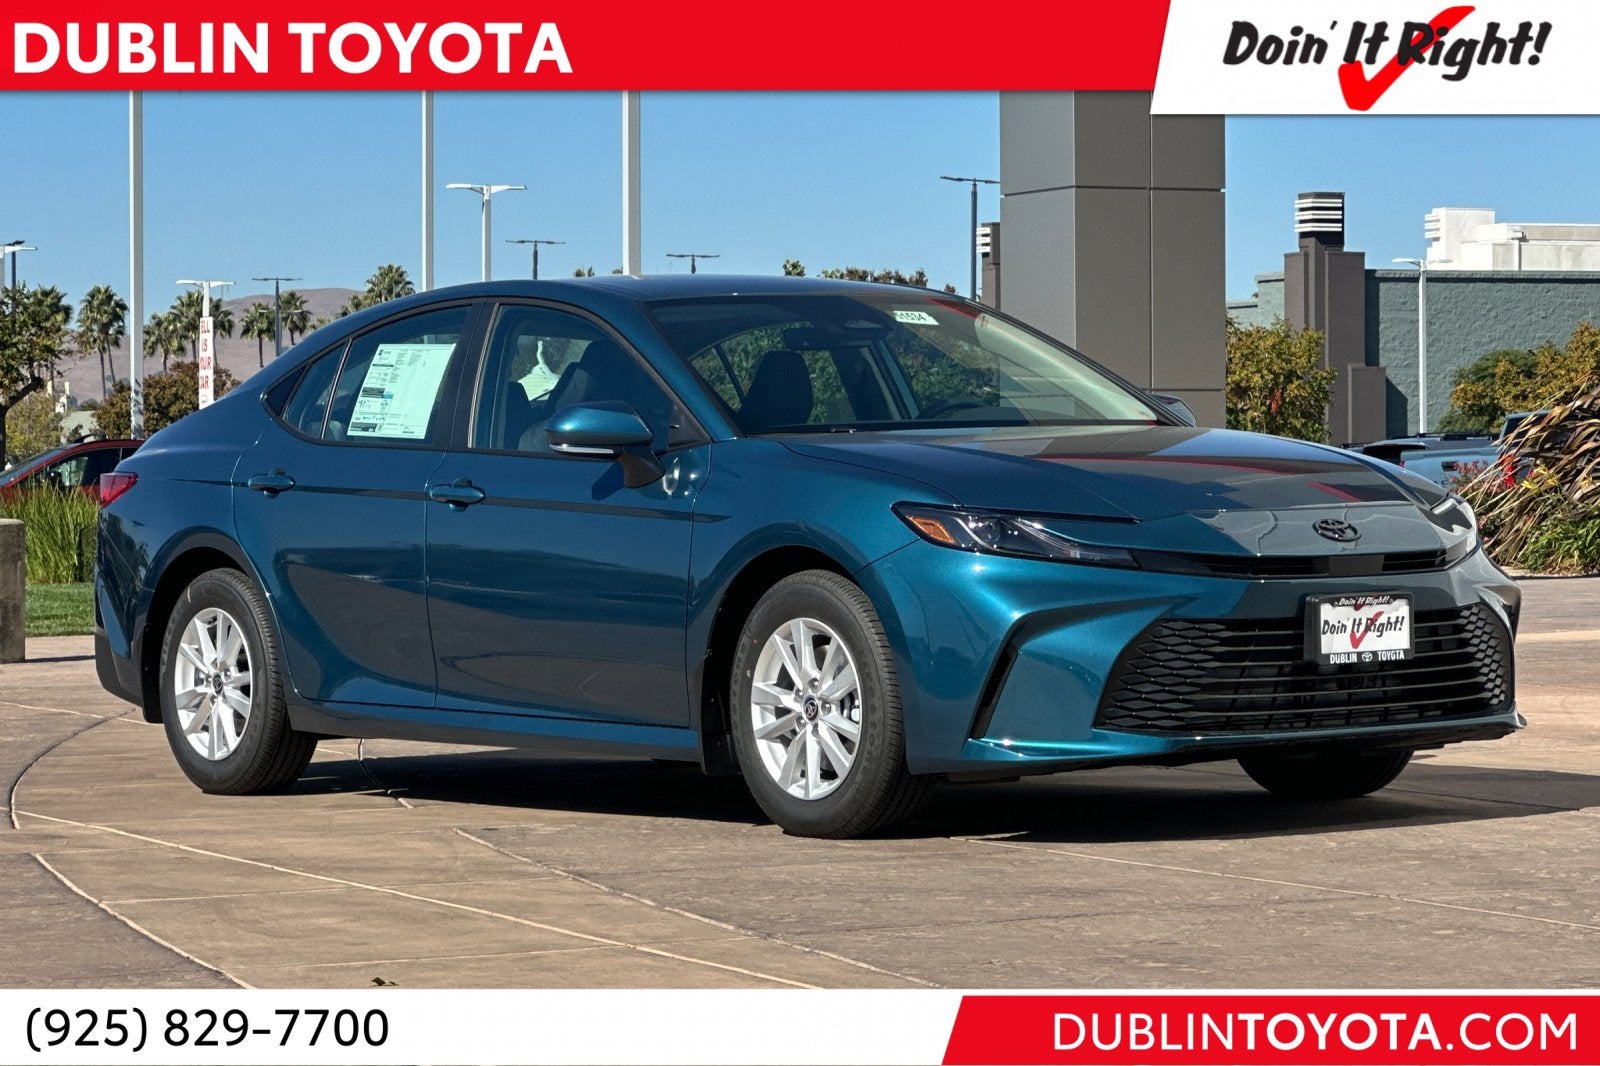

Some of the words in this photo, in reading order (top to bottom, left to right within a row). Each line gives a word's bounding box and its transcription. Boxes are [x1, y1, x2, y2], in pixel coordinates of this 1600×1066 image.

[1351, 618, 1362, 634] It
[1365, 616, 1405, 638] Right!
[1329, 653, 1358, 664] DUBLIN
[1377, 649, 1405, 661] TOYOTA
